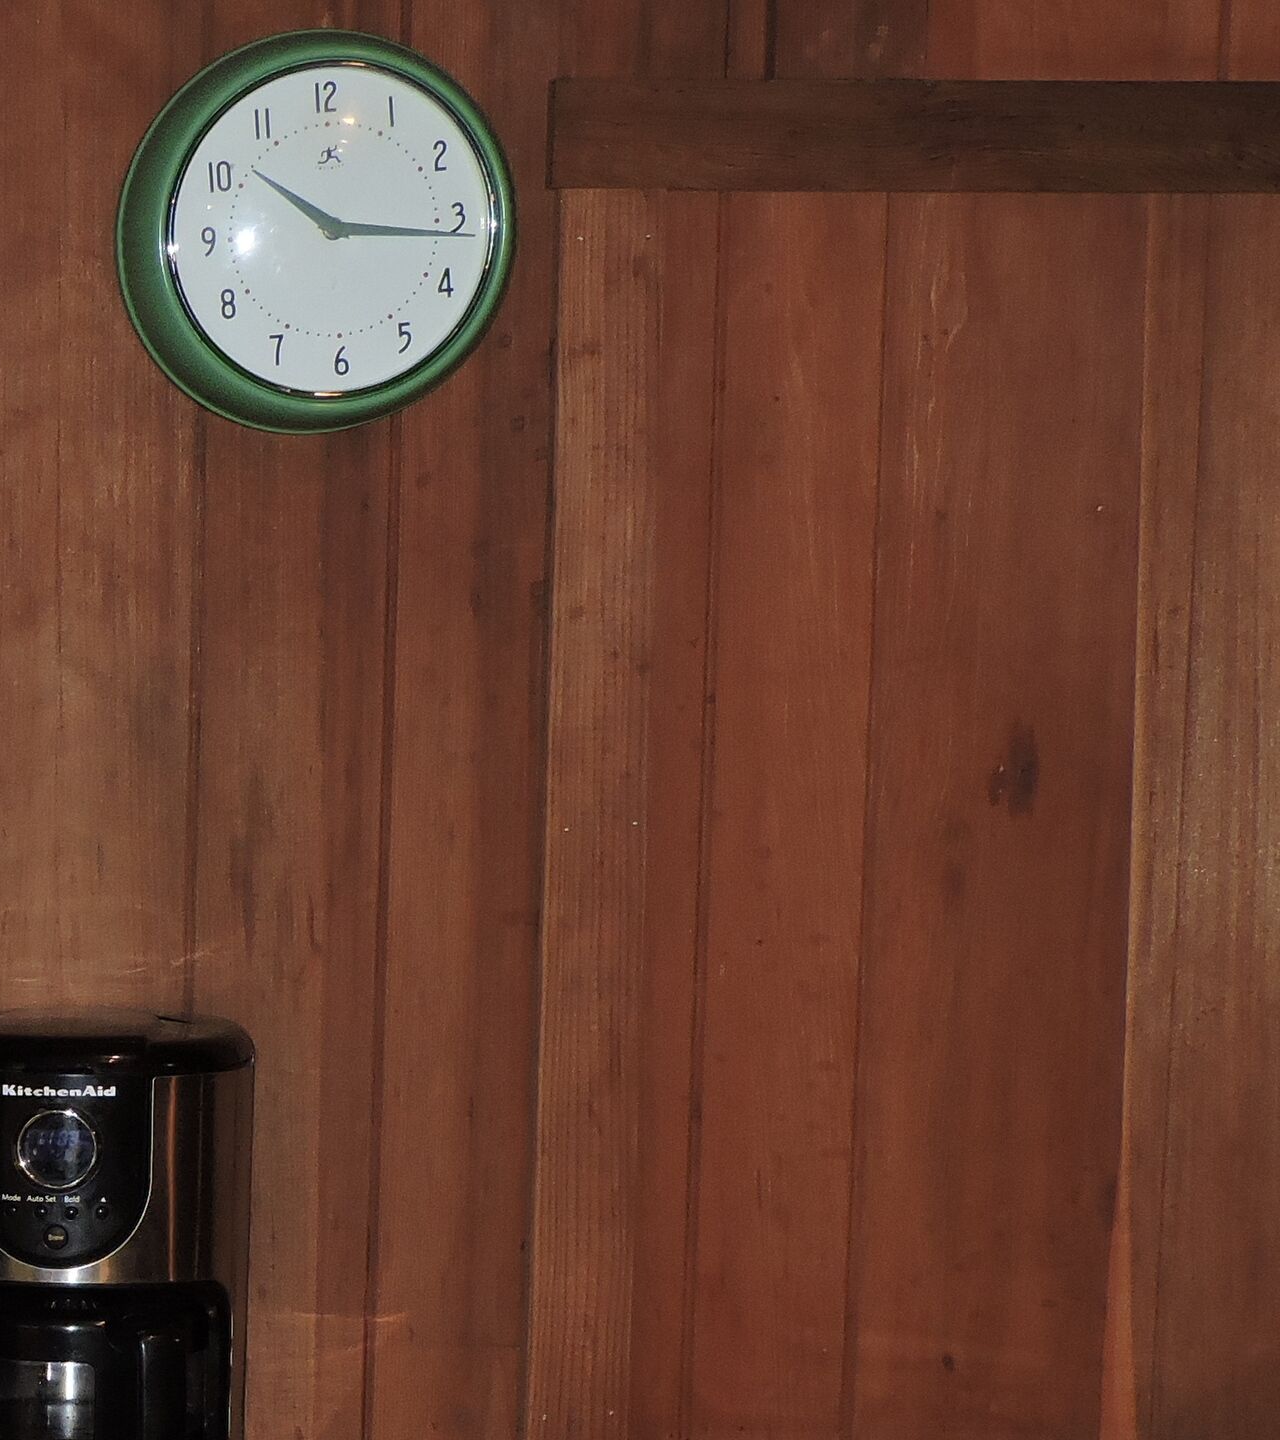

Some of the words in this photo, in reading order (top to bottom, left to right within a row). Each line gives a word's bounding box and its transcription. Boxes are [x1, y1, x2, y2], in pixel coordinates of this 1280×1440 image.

[314, 81, 337, 113] 12
[388, 96, 394, 127] 1
[255, 108, 271, 140] 11
[433, 140, 447, 172] 2
[208, 161, 232, 193] 10
[451, 202, 466, 234] 3
[201, 227, 216, 256] 9
[438, 268, 454, 299] 4
[220, 288, 236, 320] 8
[269, 334, 284, 366] 7
[398, 322, 412, 354] 5
[334, 346, 350, 376] 6
[2, 1084, 116, 1097] KitchenAid
[1, 1193, 21, 1202] Mode
[26, 1195, 44, 1203] Auto
[44, 1195, 57, 1203] Set
